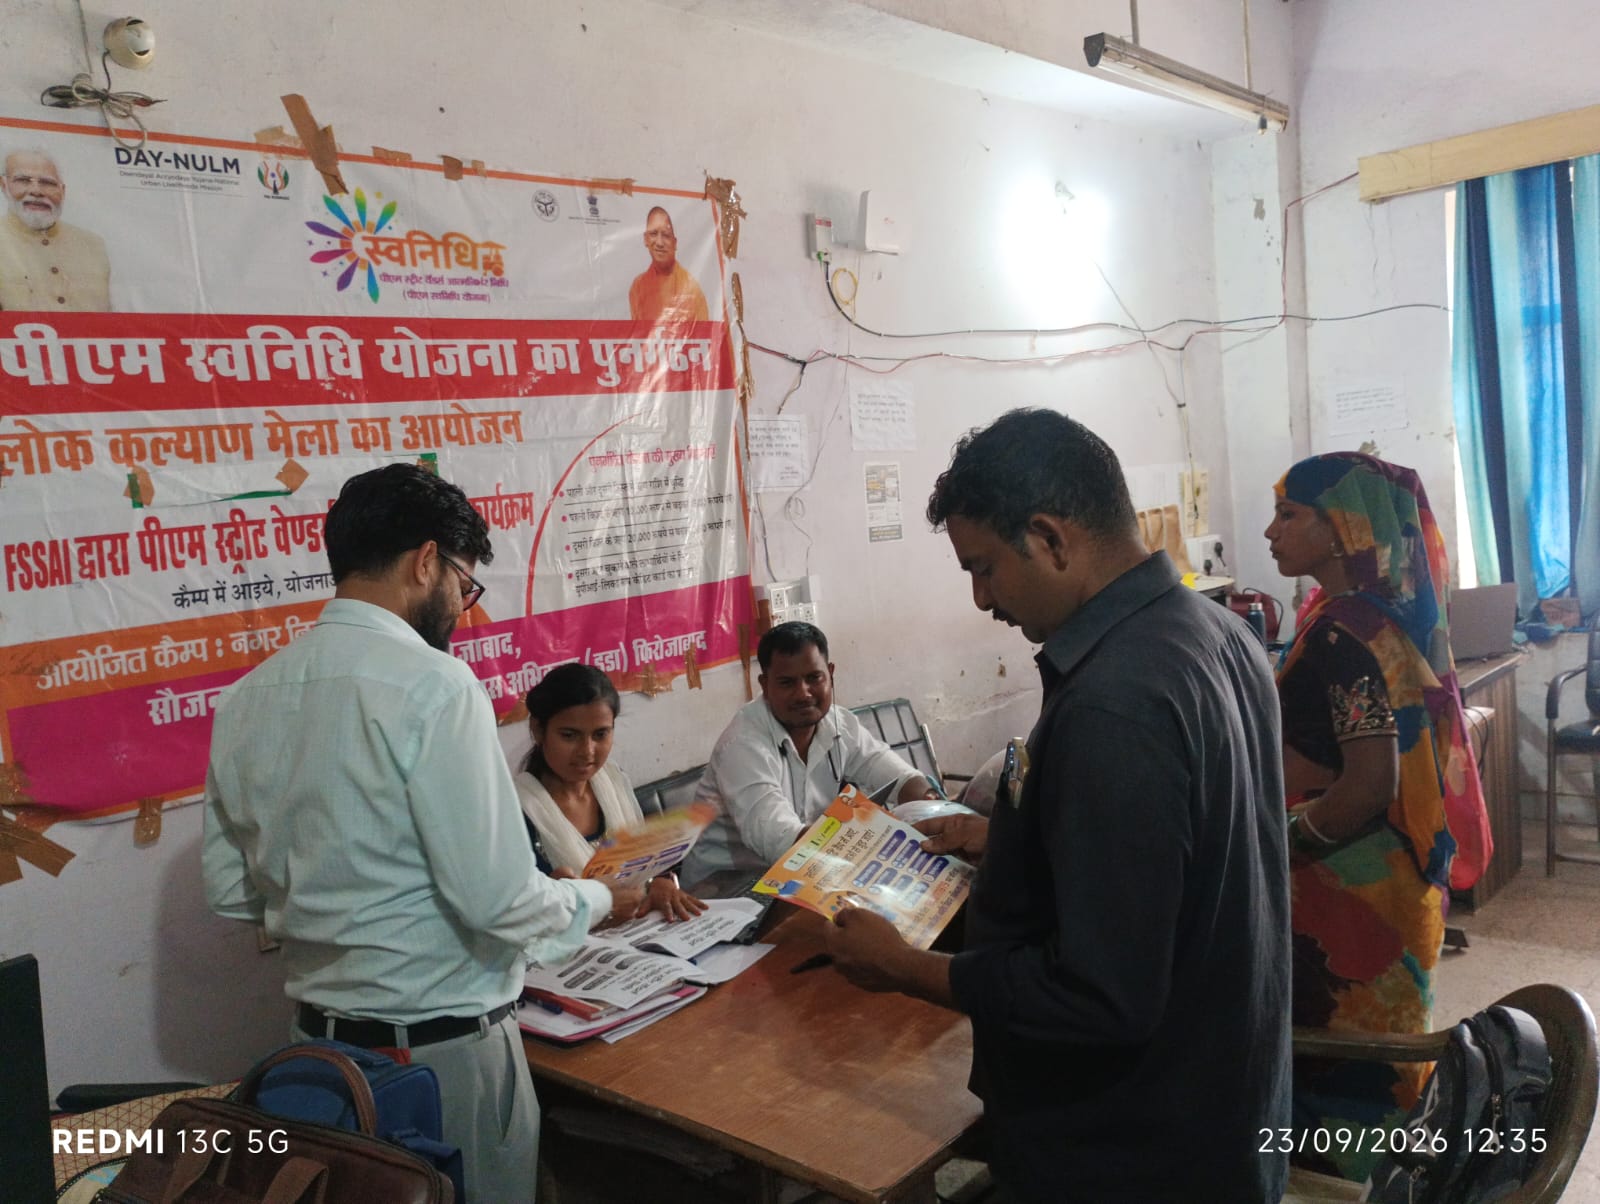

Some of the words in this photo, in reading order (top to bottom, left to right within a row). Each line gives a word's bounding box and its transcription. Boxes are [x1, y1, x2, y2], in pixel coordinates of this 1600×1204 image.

[114, 147, 240, 175] DAY-NULM
[361, 230, 480, 270] स्वनिधि
[0, 322, 165, 386] पीएम
[180, 325, 364, 382] स्वनिधि
[375, 326, 517, 378] योजना
[526, 338, 580, 375] का
[589, 326, 713, 387] पुनर्गठन
[0, 420, 94, 476] लोक
[104, 423, 254, 467] कल्याण
[263, 410, 339, 458] मेला
[347, 417, 392, 452] का
[400, 403, 524, 450] आयोजन
[4, 538, 72, 592] FSSAI
[74, 532, 130, 581] द्वारा
[136, 516, 208, 572] पीएम
[212, 508, 269, 574] स्ट्रीट
[171, 582, 209, 610] कैम्प
[212, 580, 226, 603] में
[36, 644, 148, 691] आयोजित
[153, 634, 209, 669] कैम्प
[229, 626, 283, 655] नगर
